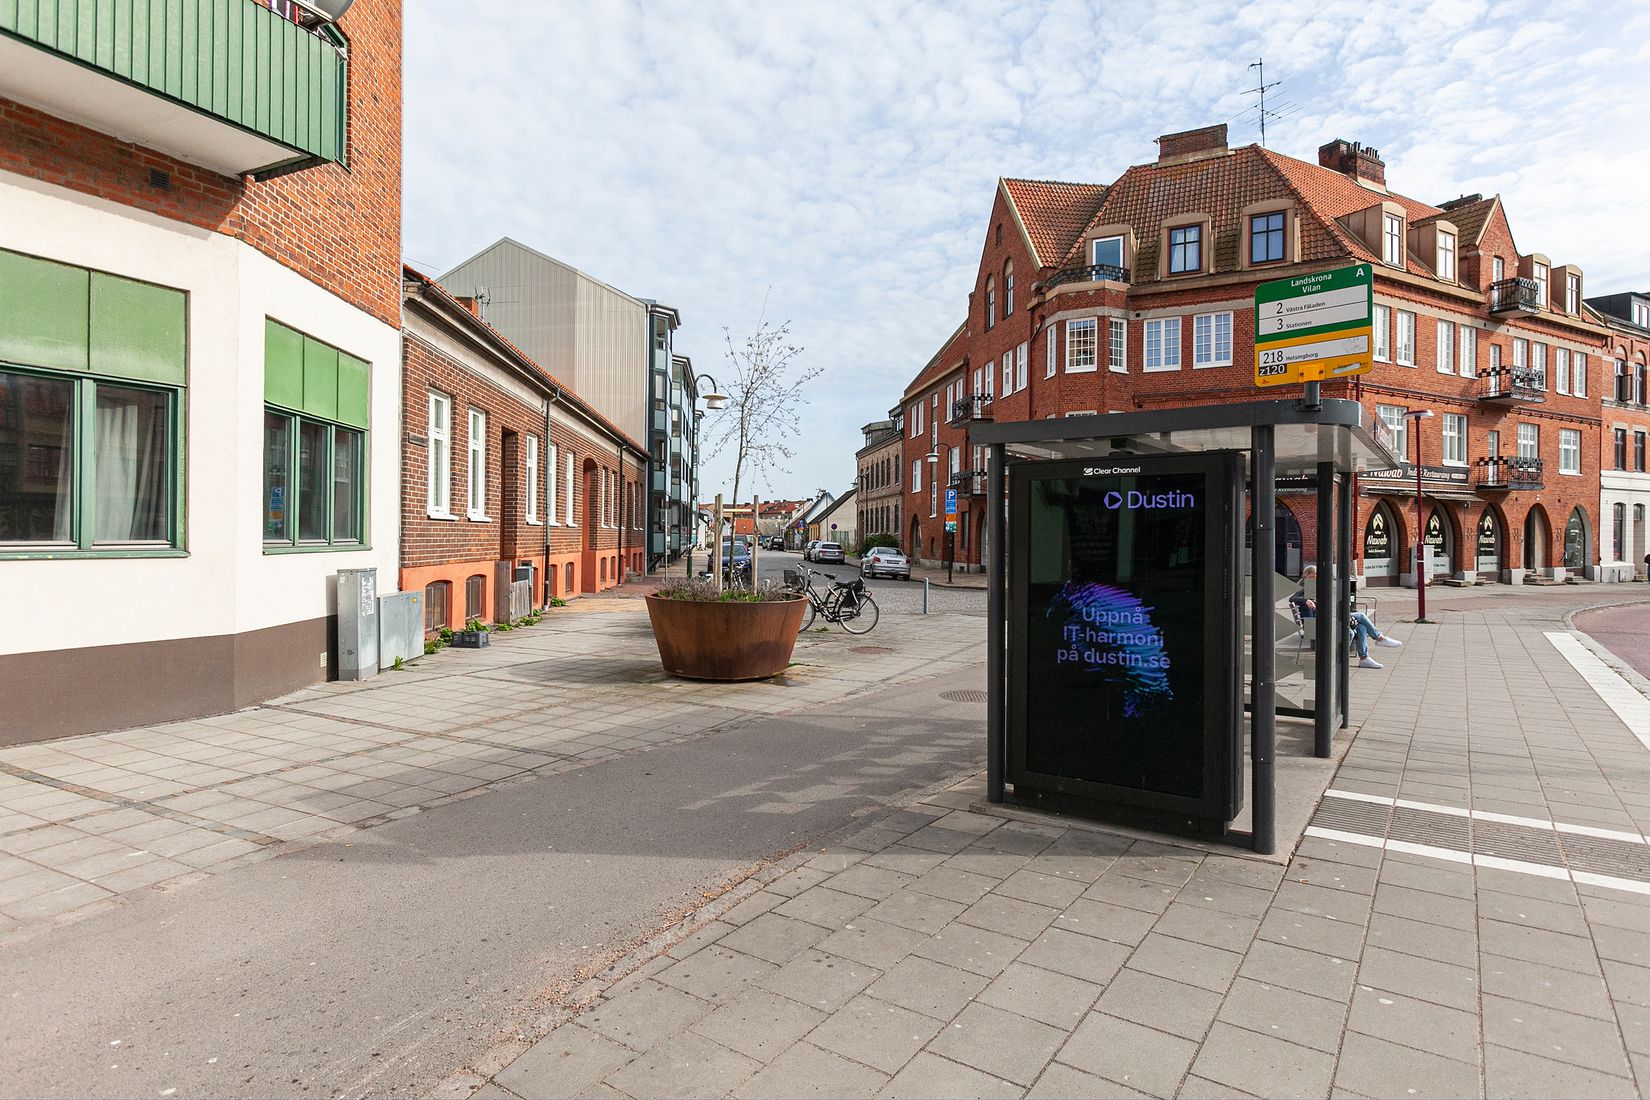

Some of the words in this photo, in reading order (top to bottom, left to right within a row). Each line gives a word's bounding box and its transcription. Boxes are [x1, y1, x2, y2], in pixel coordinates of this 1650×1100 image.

[1356, 268, 1364, 277] A
[1291, 273, 1332, 286] Landskrona
[1302, 284, 1321, 293] Vilan
[1276, 302, 1283, 314] 2
[1286, 305, 1303, 313] Västra
[1277, 318, 1283, 330] 3
[1286, 320, 1313, 329] Stationen
[1263, 350, 1284, 364] 218
[1285, 352, 1319, 361] Helsingborg
[1093, 467, 1111, 475] Clear
[1112, 466, 1141, 474] Channel
[1423, 468, 1452, 481] Restaurang
[1127, 489, 1195, 509] Dustin
[1366, 534, 1388, 546] Nawab
[1082, 606, 1144, 626] Uppnå
[1063, 625, 1164, 647] IT-harmoni
[1057, 643, 1079, 664] på
[1083, 647, 1171, 669] dustin.se
